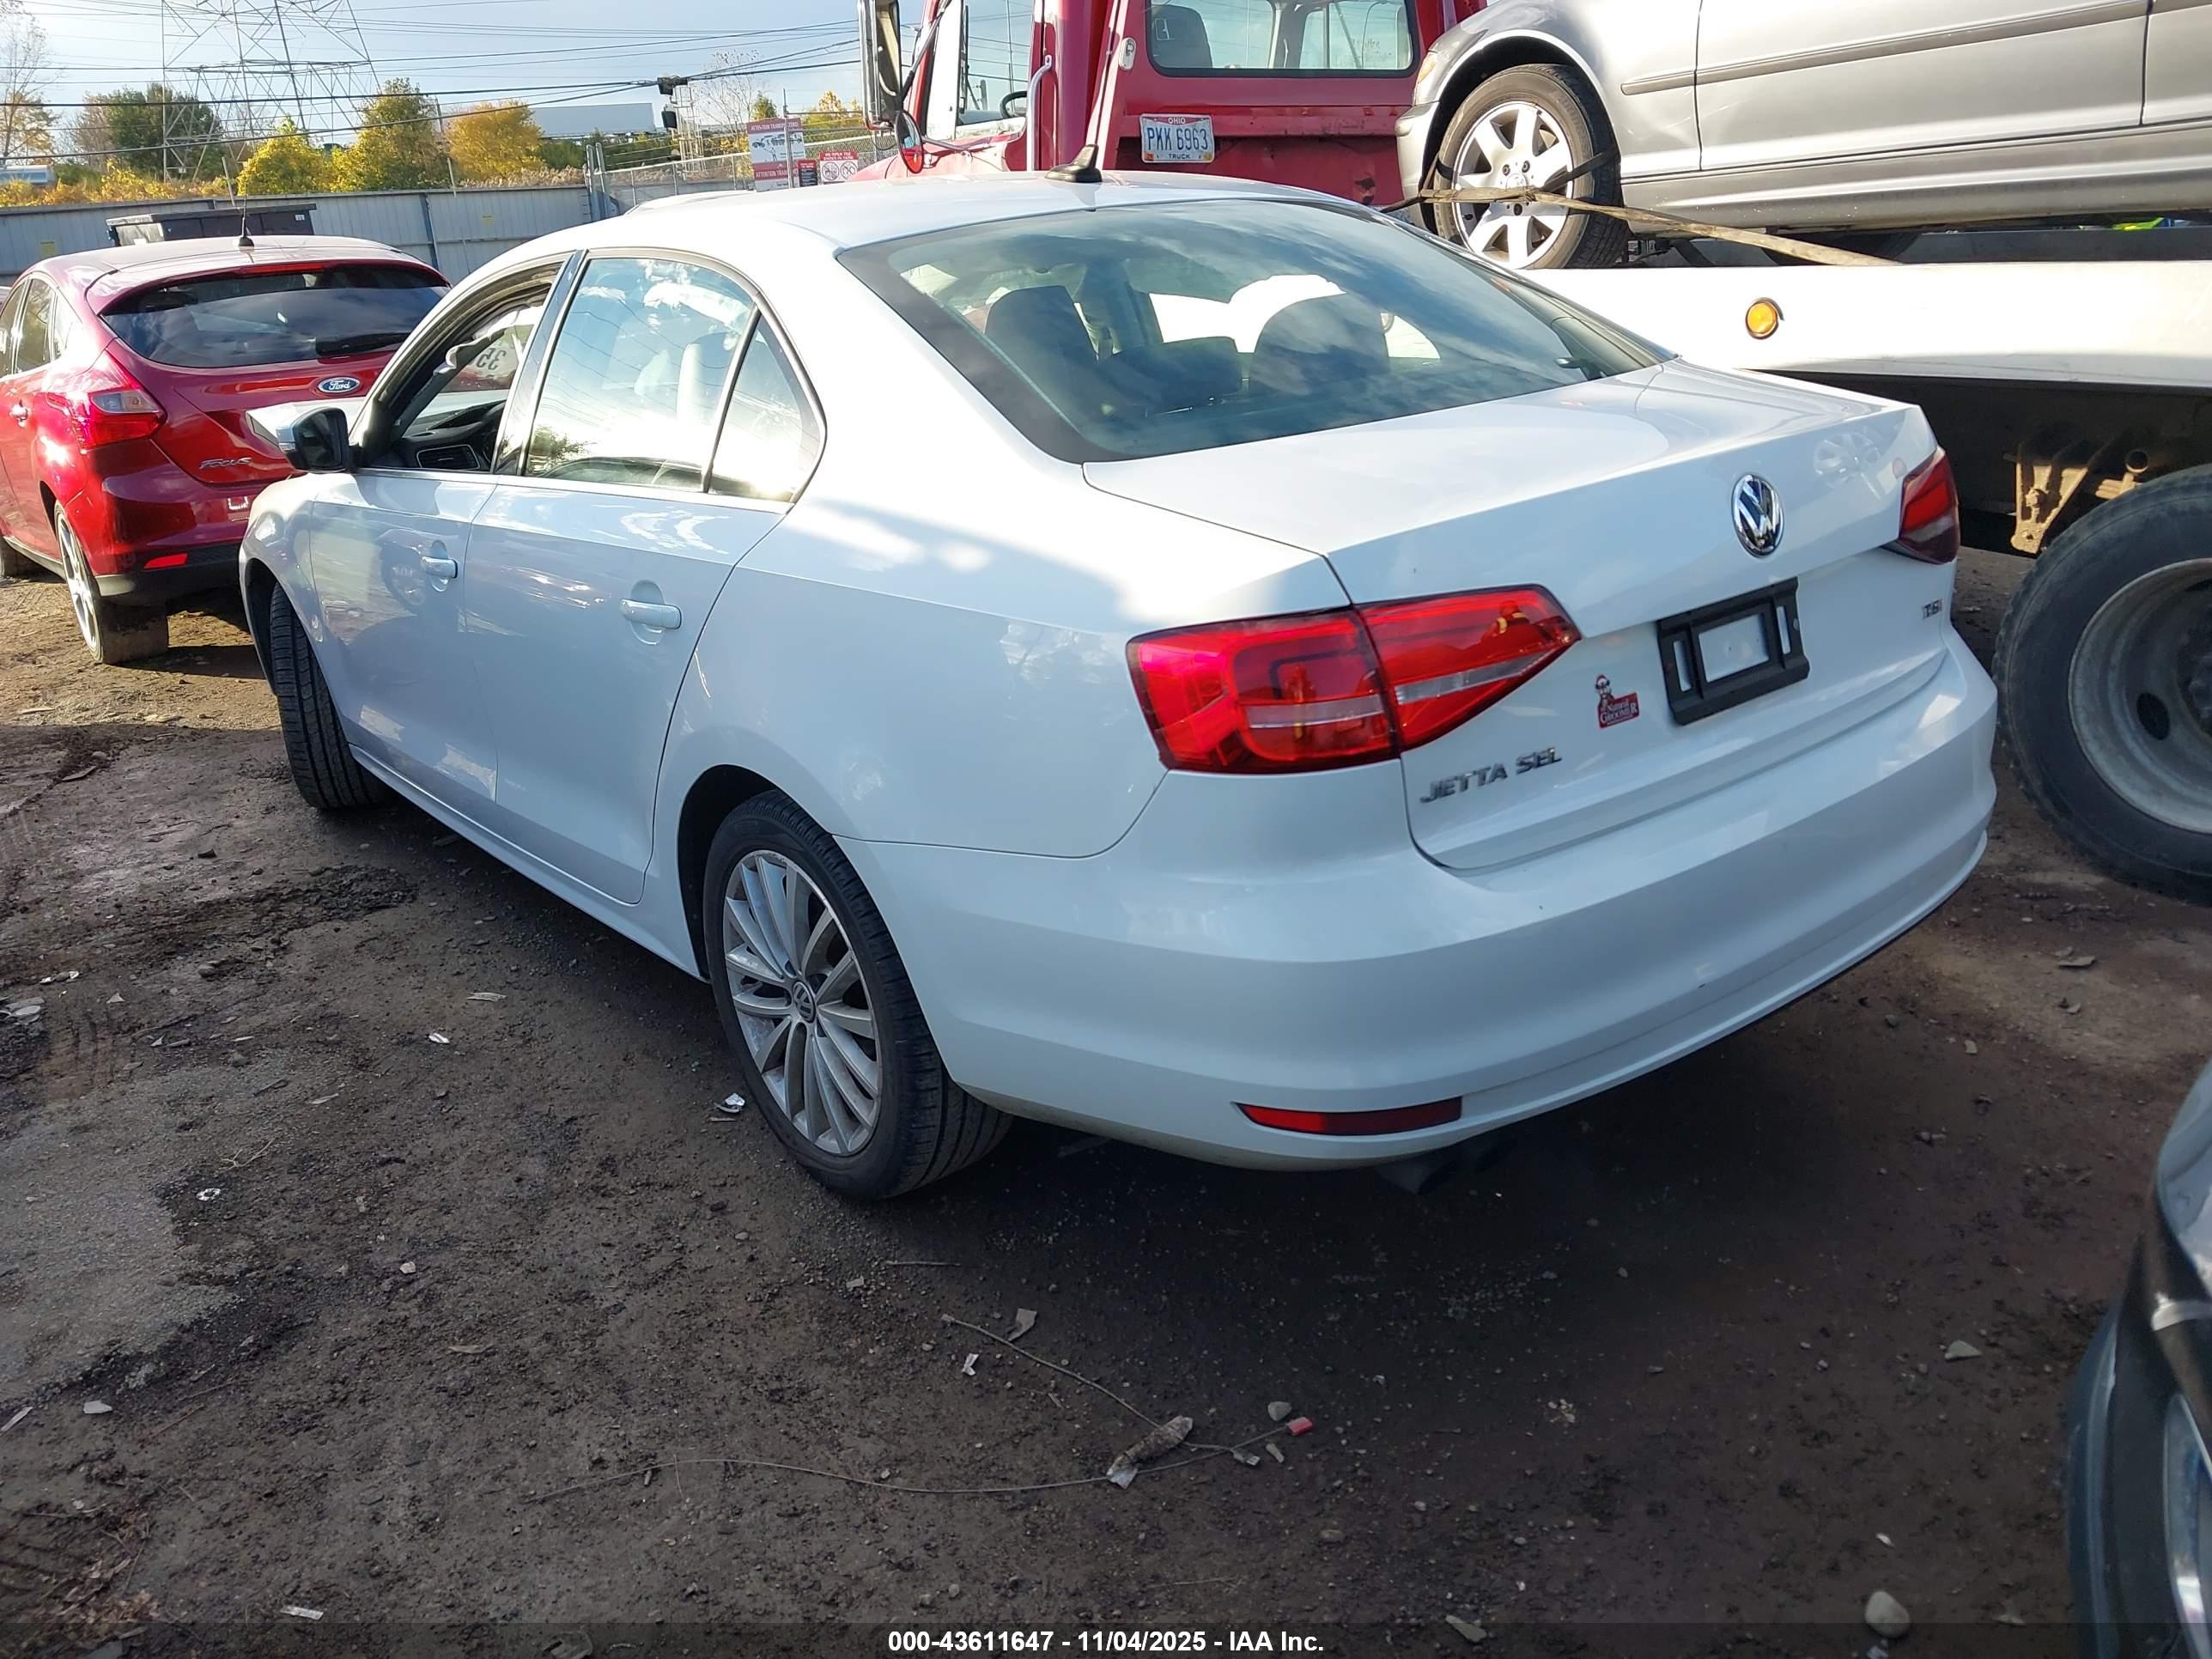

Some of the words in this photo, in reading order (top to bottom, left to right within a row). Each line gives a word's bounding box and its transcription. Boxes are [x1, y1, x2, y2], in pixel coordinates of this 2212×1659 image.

[1168, 116, 1186, 125] OHIO
[1146, 127, 1172, 151] PKK
[1176, 127, 1209, 151] 6963
[328, 380, 351, 391] Ford
[1419, 762, 1509, 804] JETTA
[1515, 745, 1563, 776] SEL
